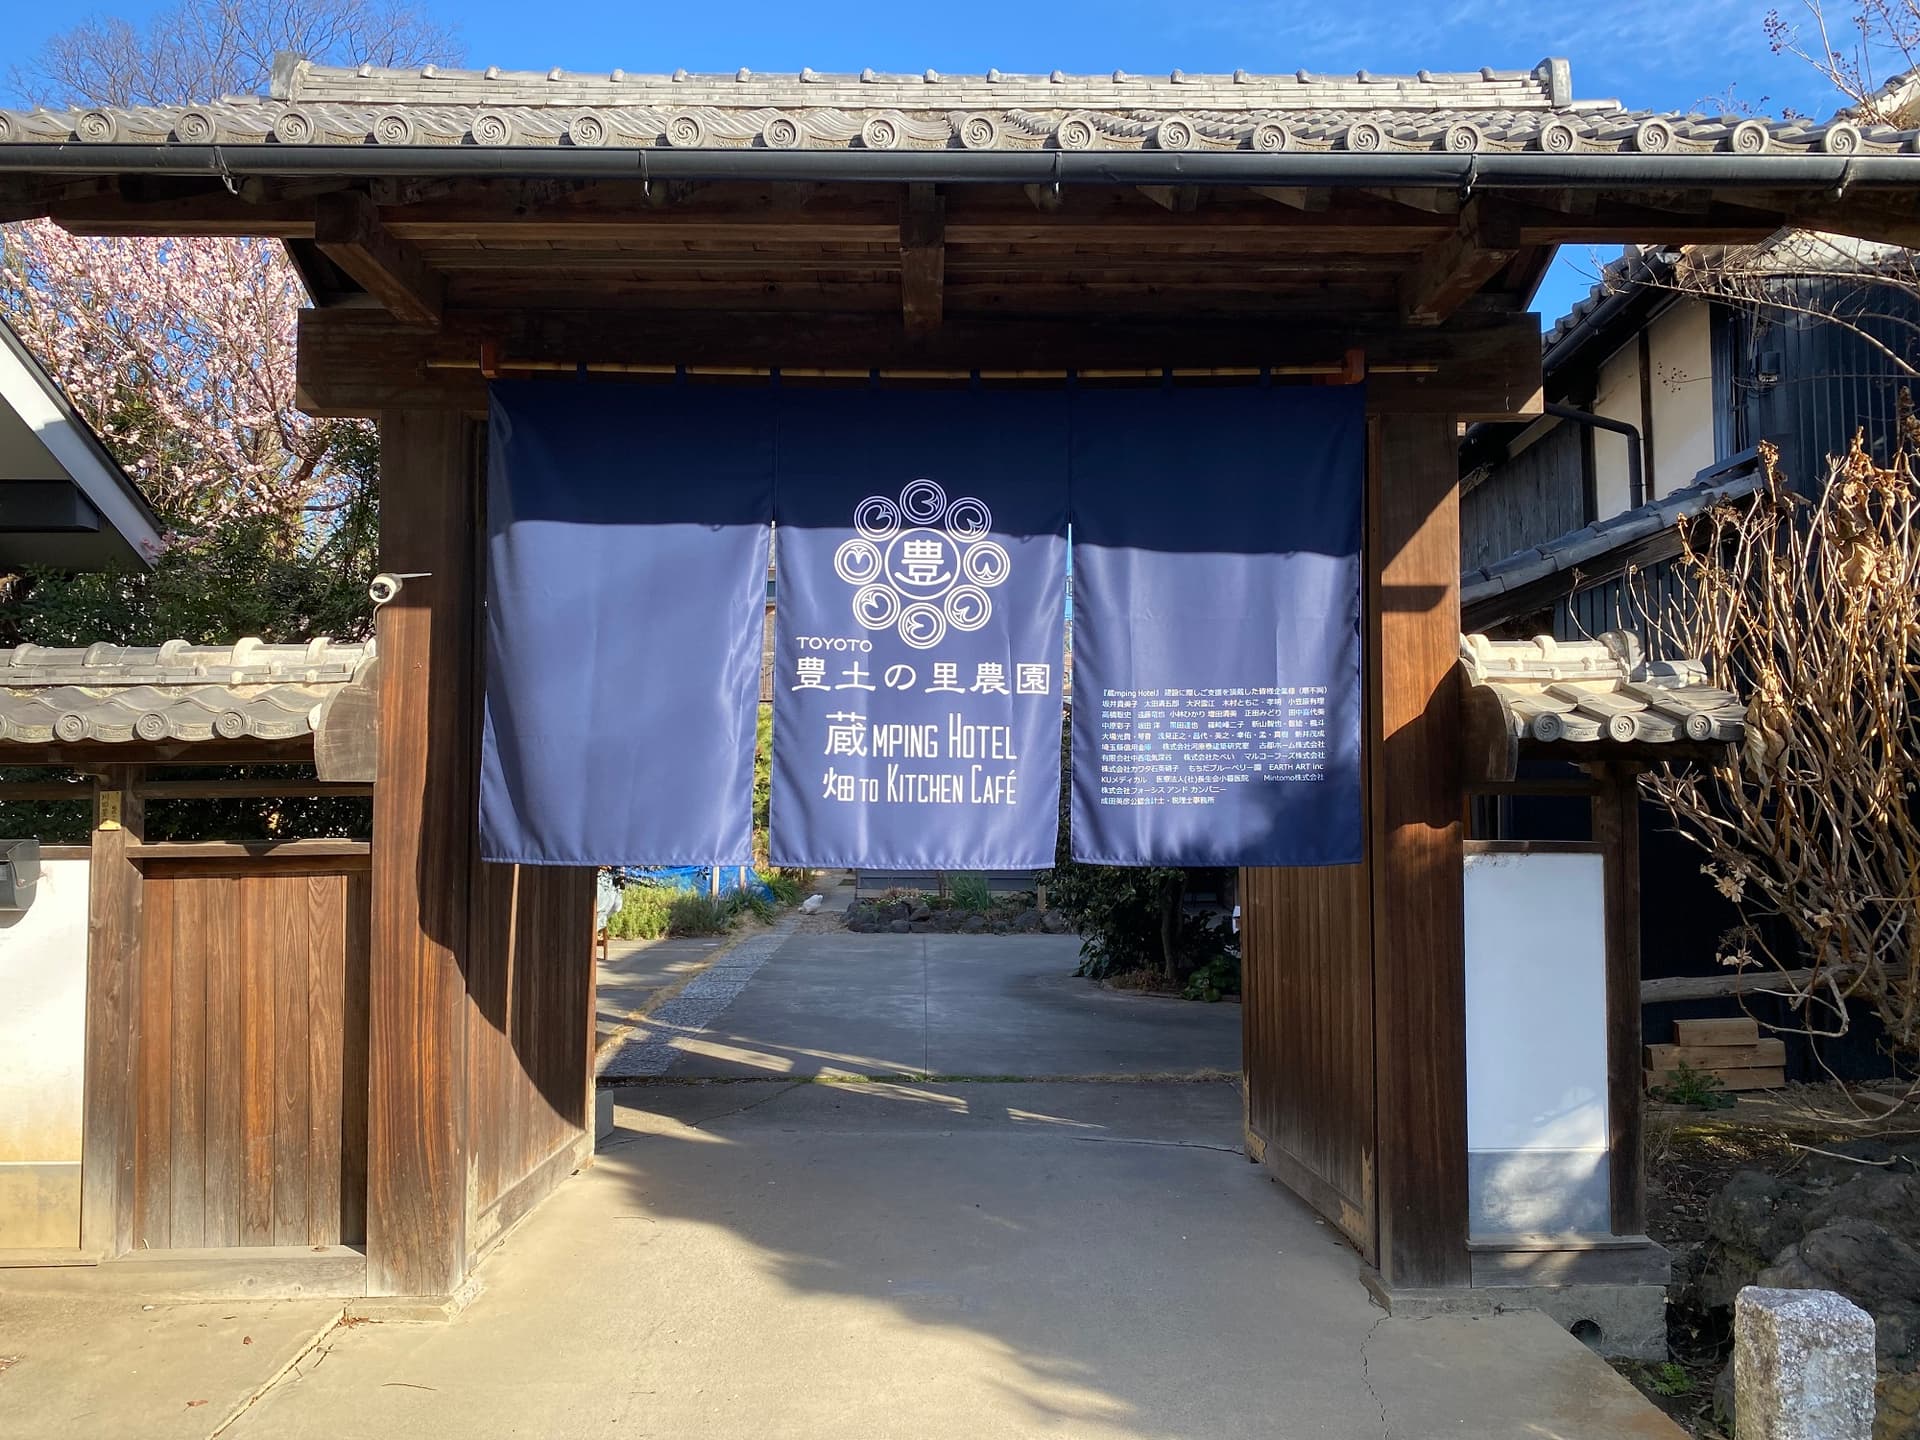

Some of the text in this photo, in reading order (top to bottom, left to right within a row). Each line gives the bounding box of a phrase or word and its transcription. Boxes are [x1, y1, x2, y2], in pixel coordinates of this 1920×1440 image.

[895, 539, 951, 586] 豊
[796, 636, 873, 653] TOYOTO
[791, 656, 1051, 695] 豊土の里農園
